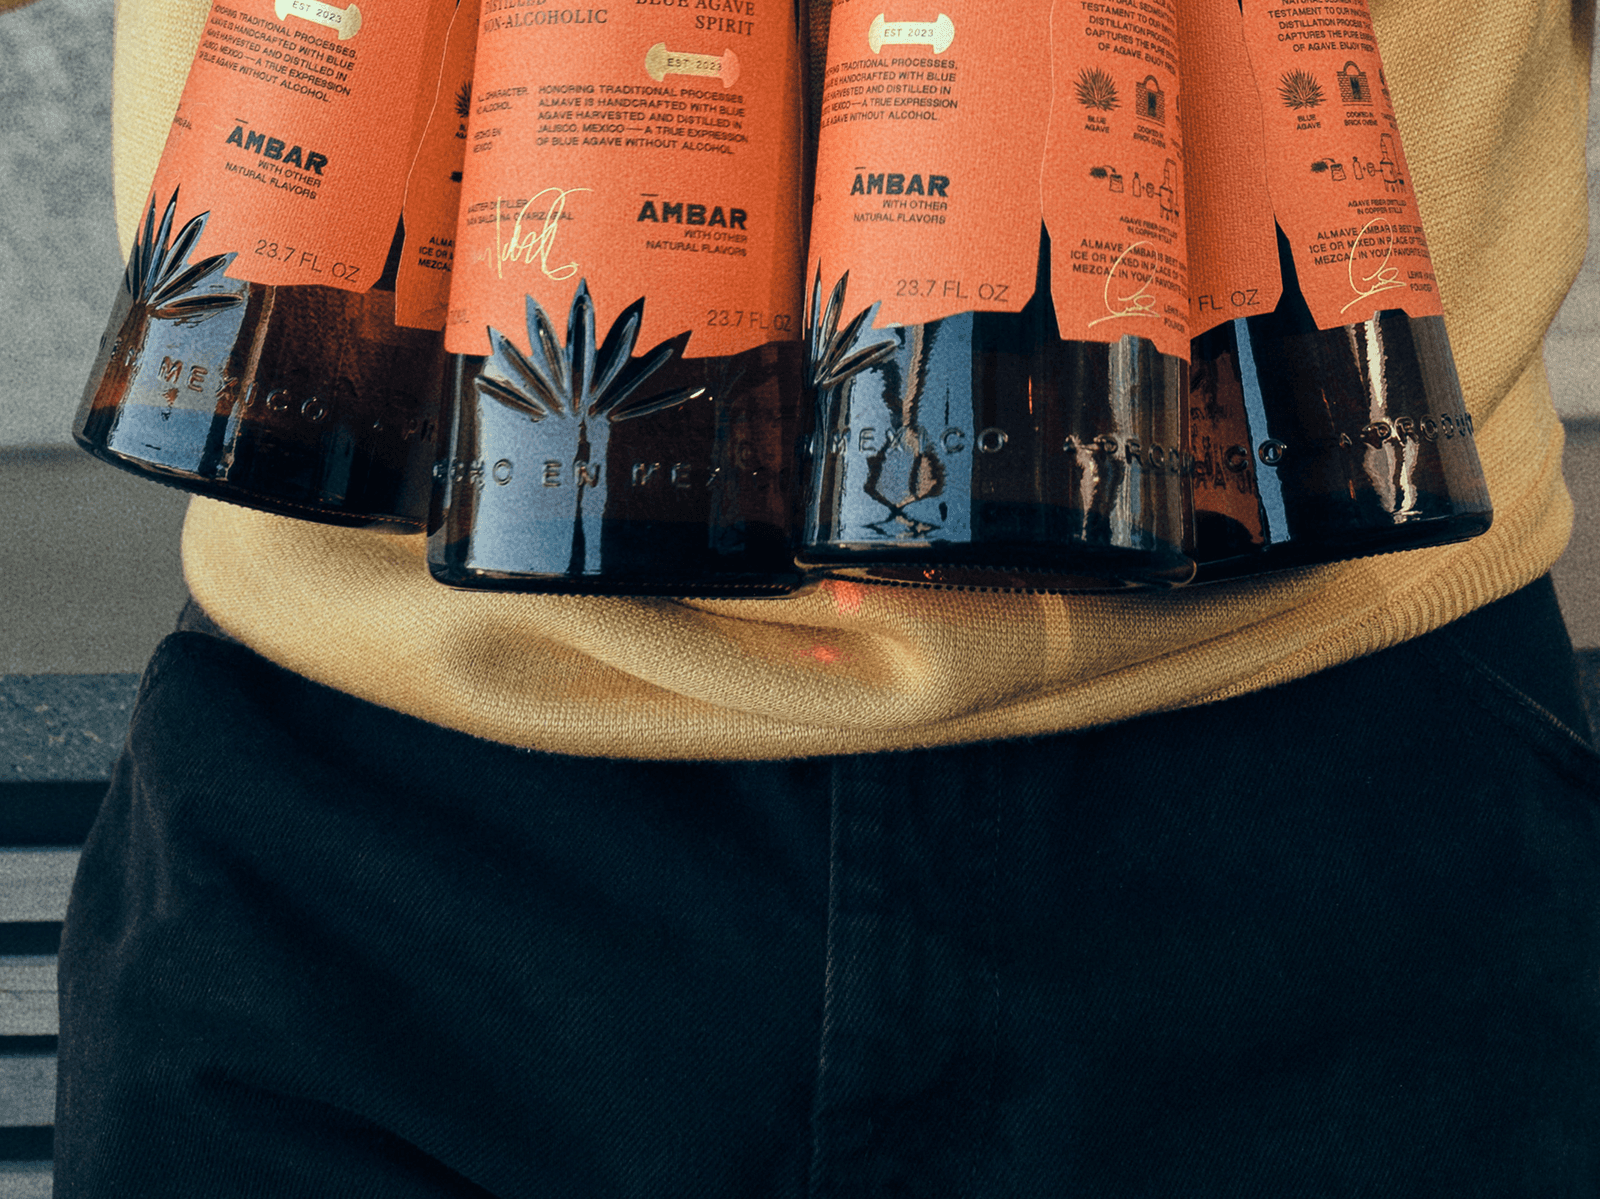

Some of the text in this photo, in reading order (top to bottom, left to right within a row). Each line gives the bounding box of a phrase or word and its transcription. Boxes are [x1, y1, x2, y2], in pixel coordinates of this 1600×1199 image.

[292, 0, 342, 24] EST 2023
[1081, 1, 1135, 19] TESTAMENT
[1268, 7, 1321, 18] TESTAMENT
[239, 12, 291, 36] TRADITIONAL
[695, 15, 755, 35] SPIRIT
[1089, 15, 1146, 35] DISTILLATION
[1278, 18, 1335, 29] DISTILLATION
[884, 29, 934, 37] EST 2023
[1085, 27, 1149, 50] CAPTURES THE
[1278, 30, 1342, 42] CAPTURES THE
[234, 24, 355, 71] HANDCRAFTED WITH BLUE
[1098, 42, 1110, 51] OF
[1292, 44, 1305, 52] OF
[262, 48, 282, 59] AND
[283, 54, 334, 76] DISTILLED
[335, 71, 348, 82] IN
[667, 58, 722, 71] EST 2023
[841, 59, 888, 70] TRADITIONAL
[239, 66, 278, 83] WITHOUT
[265, 60, 351, 96] TRUE EXPRESSION
[839, 72, 896, 84] HANDCRAFTED
[898, 71, 924, 80] WITH
[926, 72, 956, 82] BLUE
[538, 85, 678, 97] HONORING TRADITIONAL
[865, 84, 951, 95] AND DISTILLED IN
[539, 98, 745, 118] ALMAVE HANDCRAFTED WITH BLUE
[870, 97, 958, 109] TRUE EXPRESSION
[538, 111, 730, 128] AGAVE HARVESTED AND DISTILLED
[850, 111, 885, 121] WITHOUT
[1088, 115, 1106, 124] BLUE
[1297, 114, 1316, 122] BLUE
[1085, 124, 1110, 133] AGAVE
[1297, 122, 1321, 130] AGAVE
[656, 127, 749, 143] TRUE EXPRESSION
[552, 137, 579, 145] BLUE
[583, 137, 621, 146] AGAVE
[625, 138, 678, 148] WITHOUT
[258, 160, 322, 188] WITH OTHER
[225, 162, 317, 200] NATURAL FLAVORS
[882, 200, 947, 211] WITH OTHER
[1348, 199, 1370, 207] AGAVE
[853, 213, 946, 224] NATURAL FLAVORS
[1119, 215, 1141, 227] AGAVE
[684, 229, 747, 243] WITH OTHER
[1317, 228, 1358, 240] ALMAVE
[646, 240, 746, 256] NATURAL FLAVORS
[1080, 238, 1123, 252] ALMAVE
[1309, 241, 1344, 254] ICE OR
[255, 239, 360, 283] 23.7 FL OZ
[1071, 250, 1106, 263] ICE OR
[896, 279, 1010, 303] 23.7 FL OZ
[1198, 289, 1260, 311] FL OZ
[707, 309, 791, 332] 23.7 FL OZ
[543, 460, 600, 488] EN
